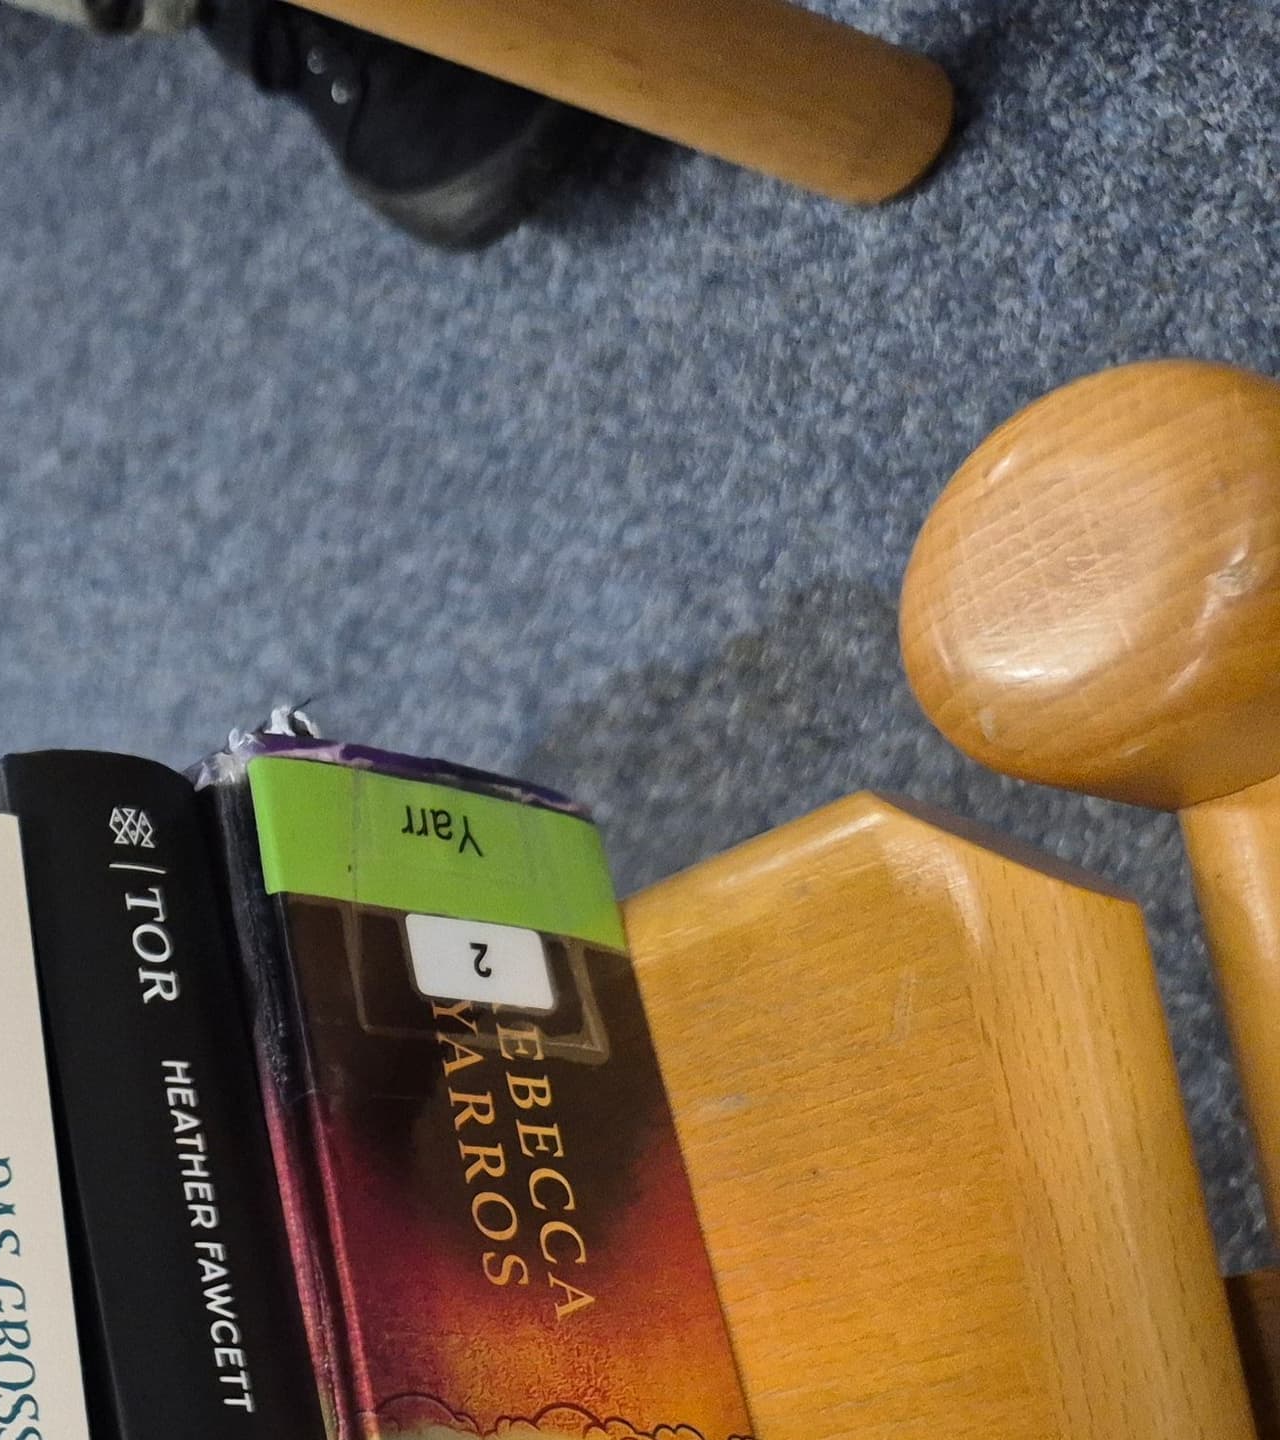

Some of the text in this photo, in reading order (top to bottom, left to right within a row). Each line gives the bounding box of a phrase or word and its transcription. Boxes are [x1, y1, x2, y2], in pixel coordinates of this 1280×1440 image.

[401, 804, 486, 858] Yarr
[123, 885, 180, 1006] TOR
[468, 941, 493, 980] 2
[160, 1058, 258, 1416] HEATHER FAWCETT
[431, 1001, 530, 1287] YARROS
[492, 1003, 596, 1323] EBECCA
